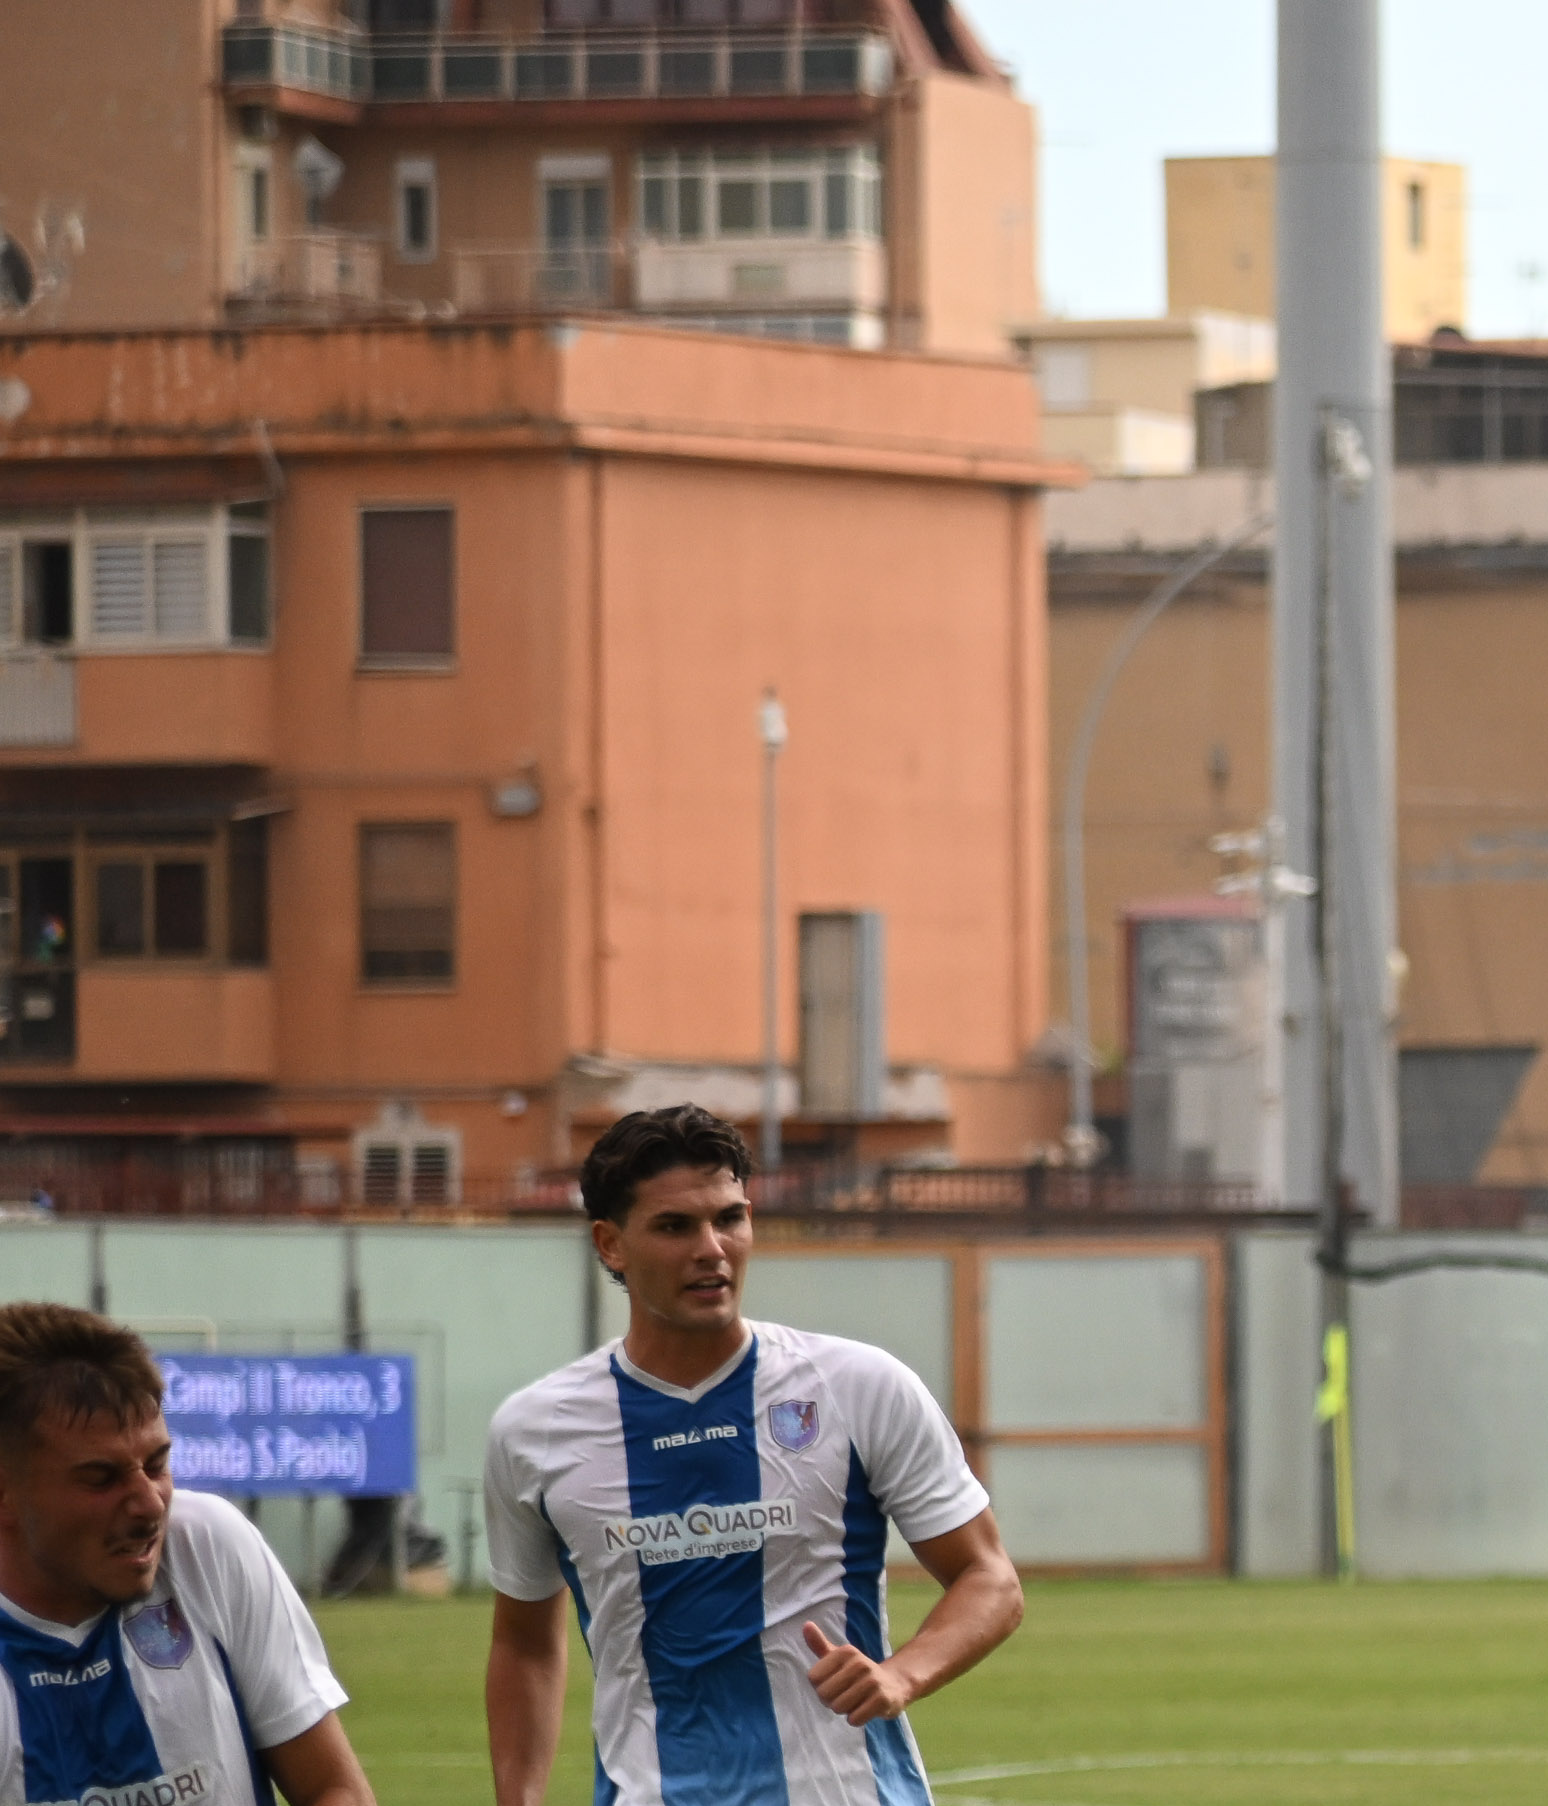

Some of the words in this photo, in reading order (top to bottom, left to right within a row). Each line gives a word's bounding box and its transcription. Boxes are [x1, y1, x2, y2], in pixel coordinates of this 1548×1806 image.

[604, 1519, 682, 1551] NOVA
[687, 1505, 793, 1536] QUADRI
[643, 1546, 679, 1563] Rete
